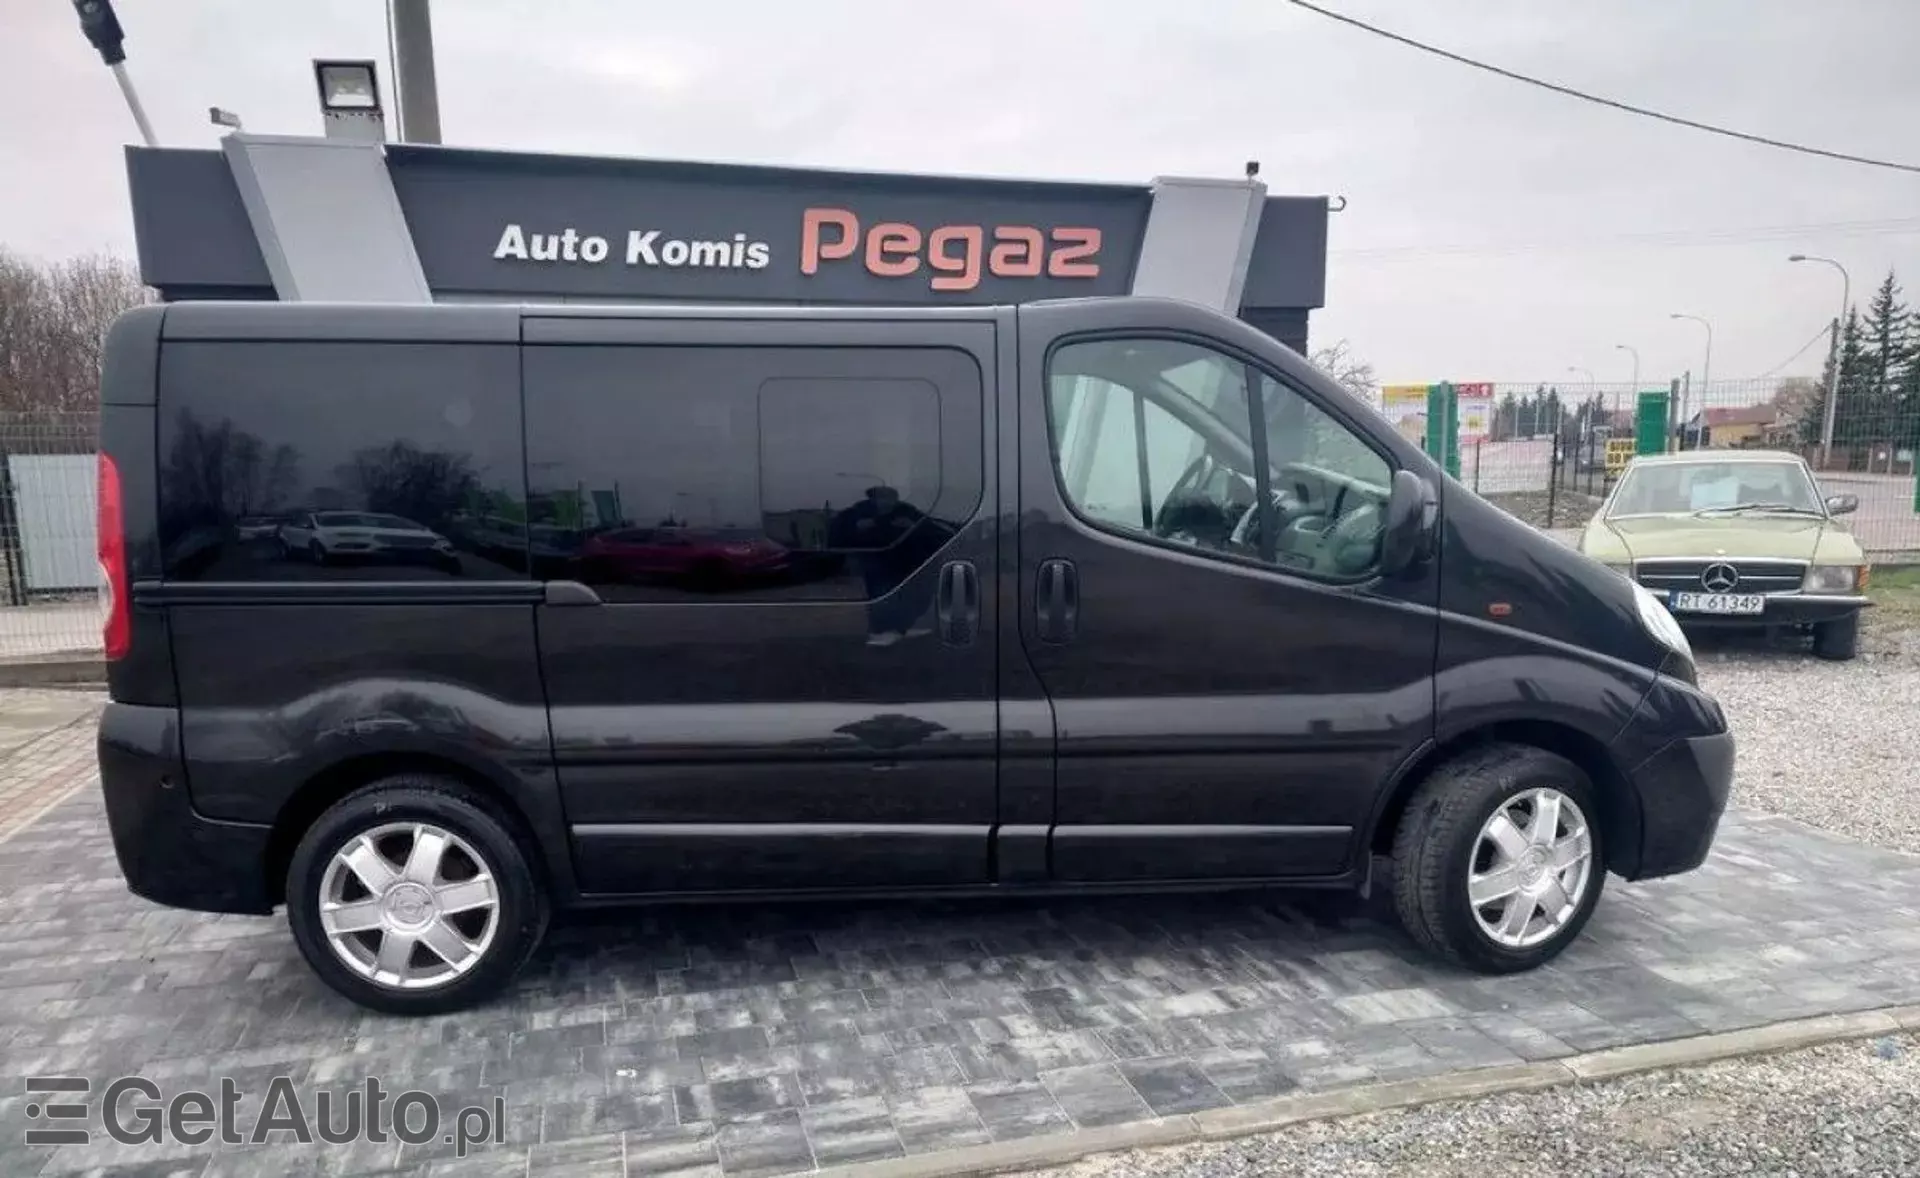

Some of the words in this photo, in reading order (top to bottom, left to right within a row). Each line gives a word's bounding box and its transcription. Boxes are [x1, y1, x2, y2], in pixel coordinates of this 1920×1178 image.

[494, 223, 608, 264] Auto
[626, 230, 770, 269] Komis
[800, 208, 1102, 291] Pegaz
[1680, 593, 1700, 609] RT
[1708, 594, 1760, 611] 61349
